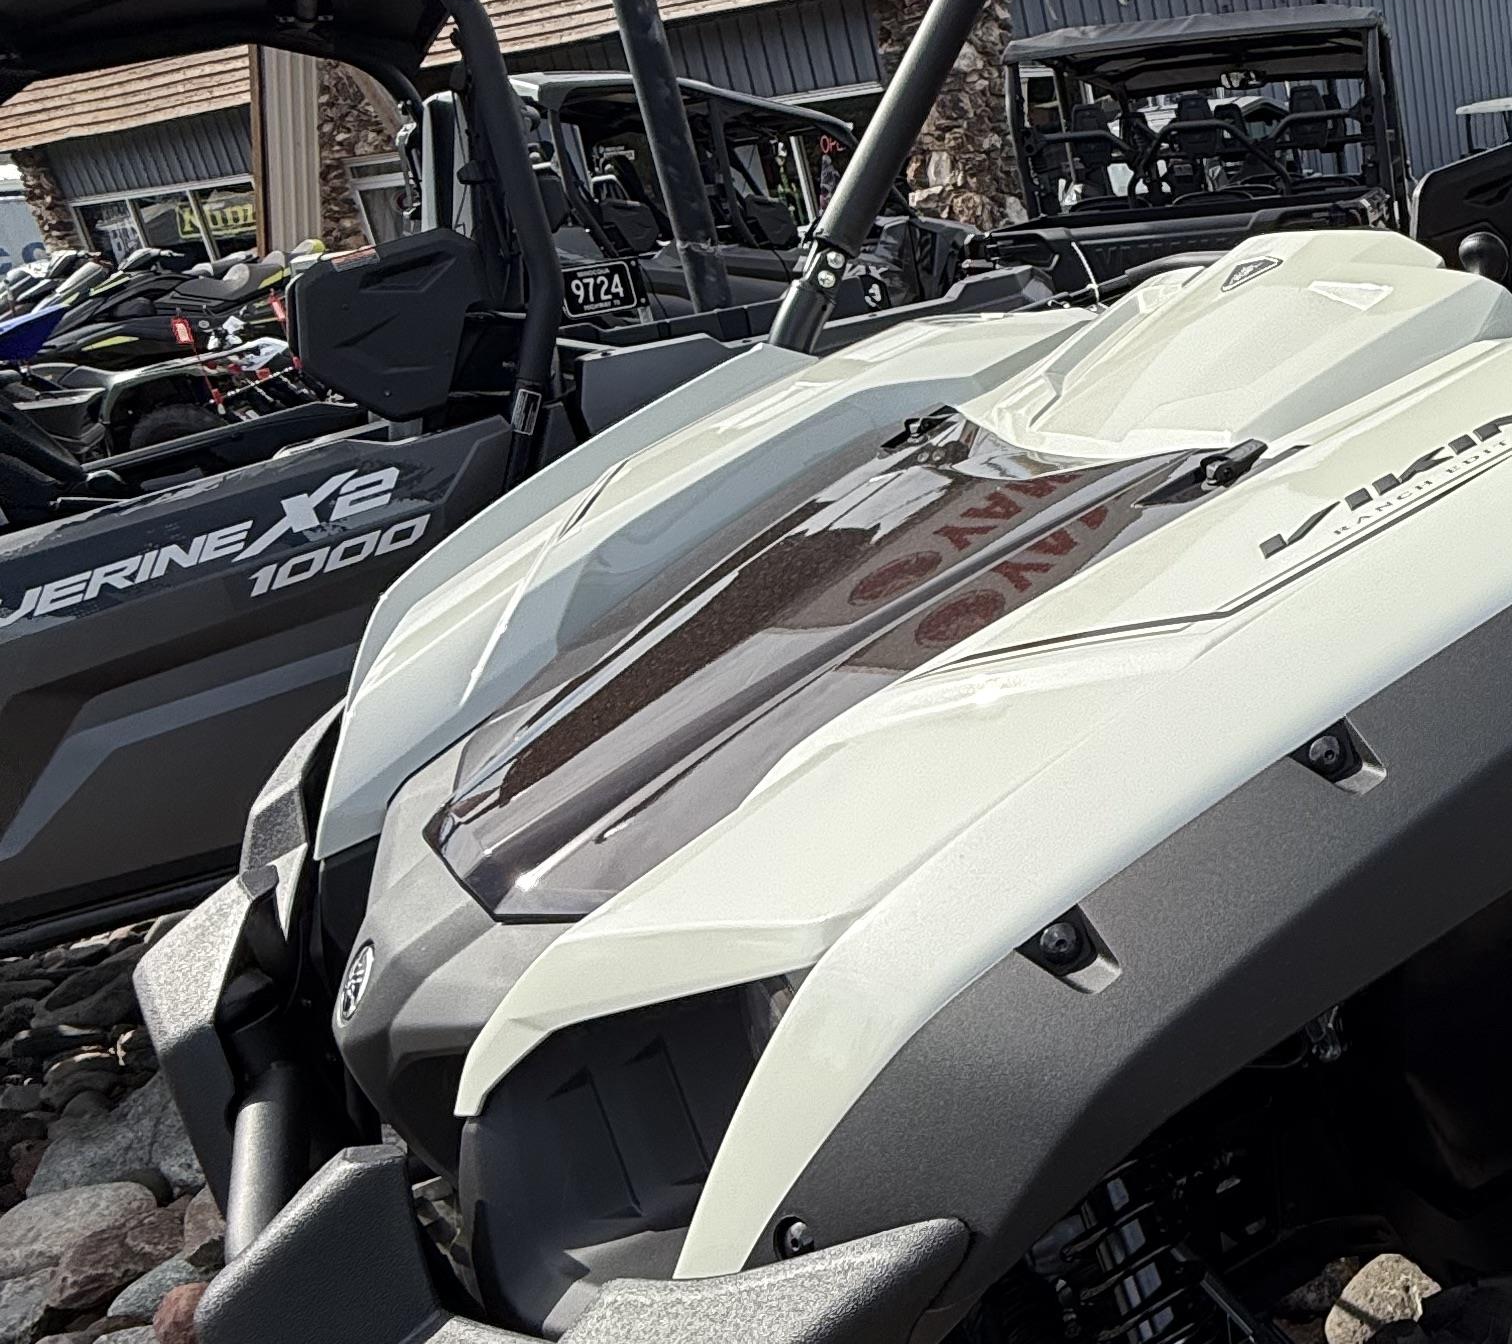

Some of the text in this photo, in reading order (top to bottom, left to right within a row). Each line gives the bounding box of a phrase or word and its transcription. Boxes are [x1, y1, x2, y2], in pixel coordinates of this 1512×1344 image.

[571, 273, 625, 304] 9724
[1333, 479, 1434, 536] RANCH
[249, 513, 431, 598] 1000
